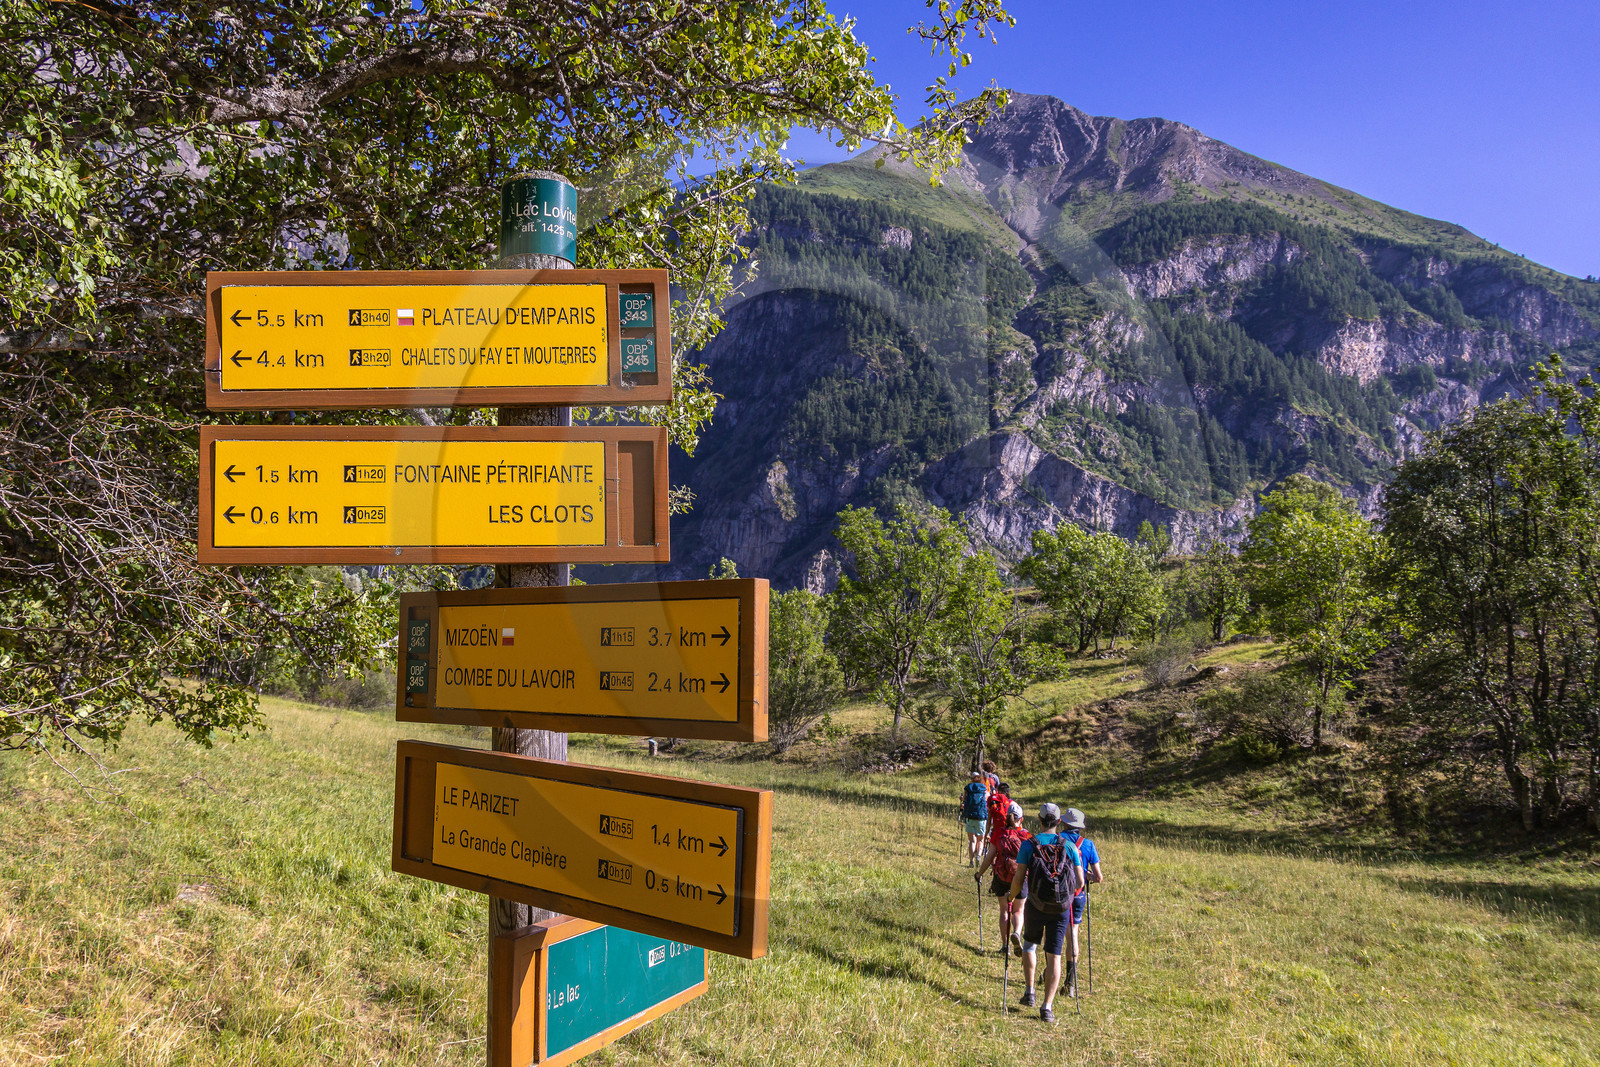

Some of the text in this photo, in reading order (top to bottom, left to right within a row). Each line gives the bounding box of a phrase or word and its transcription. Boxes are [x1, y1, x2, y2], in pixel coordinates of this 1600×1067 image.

[515, 201, 539, 217] Lac
[541, 222, 565, 236] 1425
[625, 300, 647, 310] OBP
[257, 307, 596, 328] 5.5 km 3h40 PLATEAU D'EMPARIS
[625, 310, 648, 321] 343
[256, 346, 597, 368] 4.4 km 3h20 CHALETS DU FAY ET MOUTERRES
[626, 345, 648, 355] OBP
[626, 355, 649, 366] 345
[255, 460, 593, 483] 1.5 km 1h20 FONTAINE PÉTRIFIANTE
[250, 505, 594, 525] 0.6 km 0h25 LES CLOTS
[411, 627, 426, 637] OBP
[445, 624, 706, 647] MIZOËN 1h15 3.7 km
[410, 637, 426, 647] 343
[410, 666, 425, 676] OBP
[409, 676, 424, 687] 345
[444, 668, 706, 693] COMBE DU LAVOIR 0h45 2.4 km
[443, 787, 458, 806] LE
[462, 790, 520, 817] PARIZET
[610, 818, 632, 835] 0h55
[651, 825, 671, 847] 1.4
[677, 829, 704, 854] km
[441, 826, 703, 901] La Grande Clapière 0h10 0.5 km
[553, 990, 564, 1009] Le
[566, 984, 580, 1003] lac
[670, 941, 681, 958] 0.2
